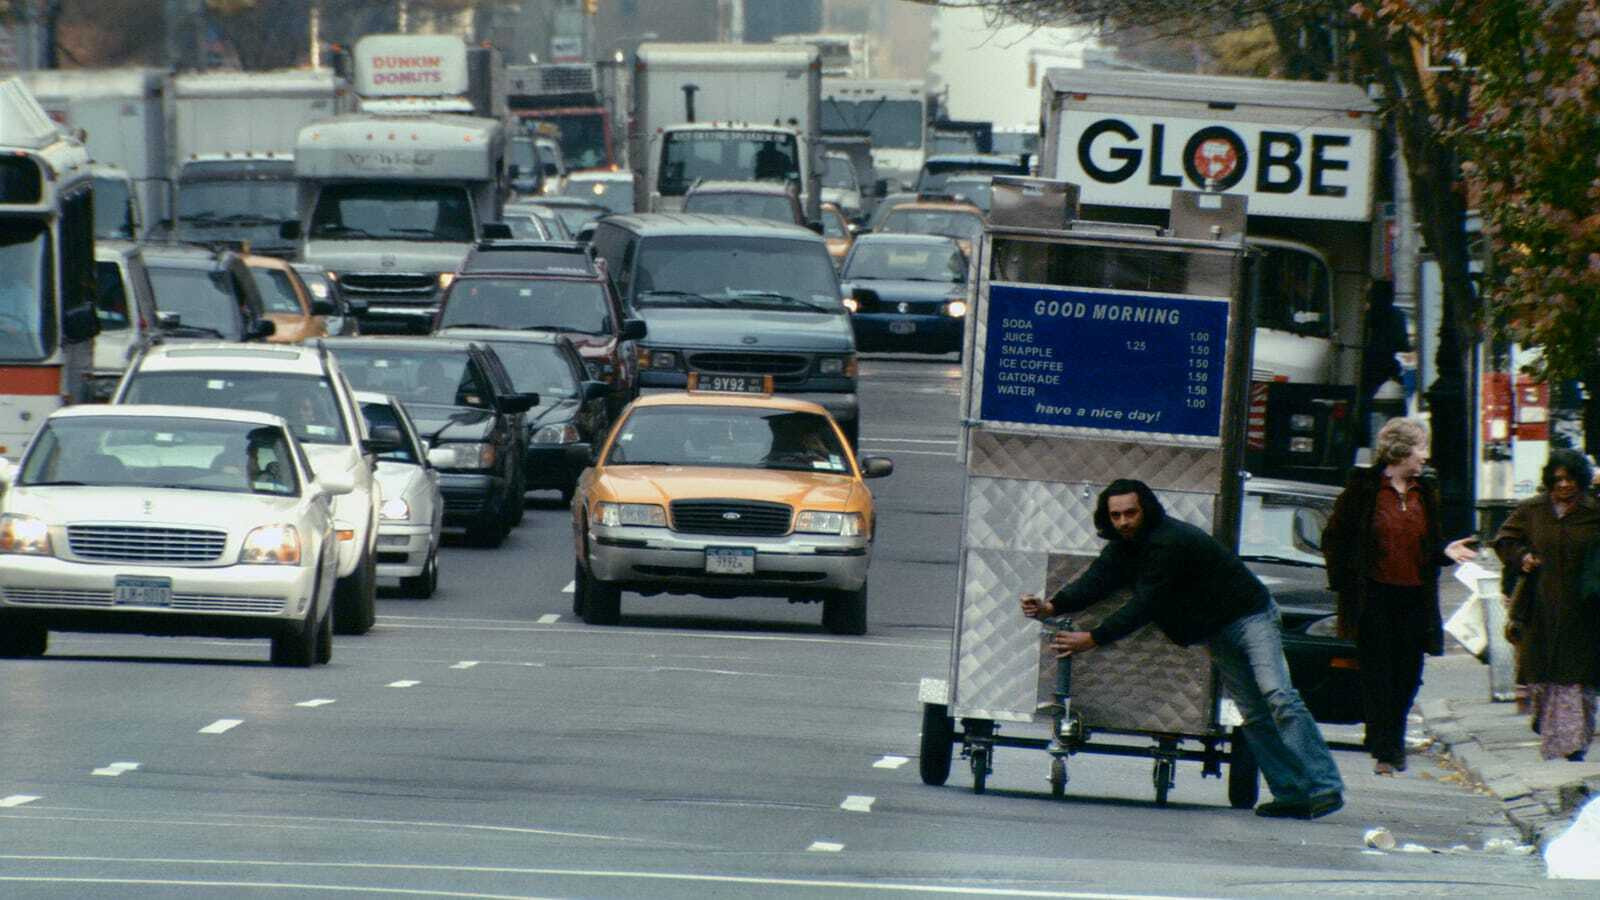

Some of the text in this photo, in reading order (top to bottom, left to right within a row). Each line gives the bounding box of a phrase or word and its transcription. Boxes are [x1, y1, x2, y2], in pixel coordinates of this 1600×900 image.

[373, 71, 442, 85] DONUTS
[1076, 117, 1352, 198] GLOBE
[1034, 300, 1180, 324] GOOD MORNING
[1002, 318, 1209, 342] SODA 1.00
[1001, 345, 1053, 357] SNAPPLE
[1002, 332, 1210, 355] JUICE 1.25 1.50
[999, 358, 1207, 382] ICE COFFEE 1.50
[713, 377, 746, 391] 9Y92
[998, 371, 1207, 395] GATORADE 1.50
[997, 384, 1205, 408] WATER 1.00
[1035, 402, 1161, 423] have a nice day!
